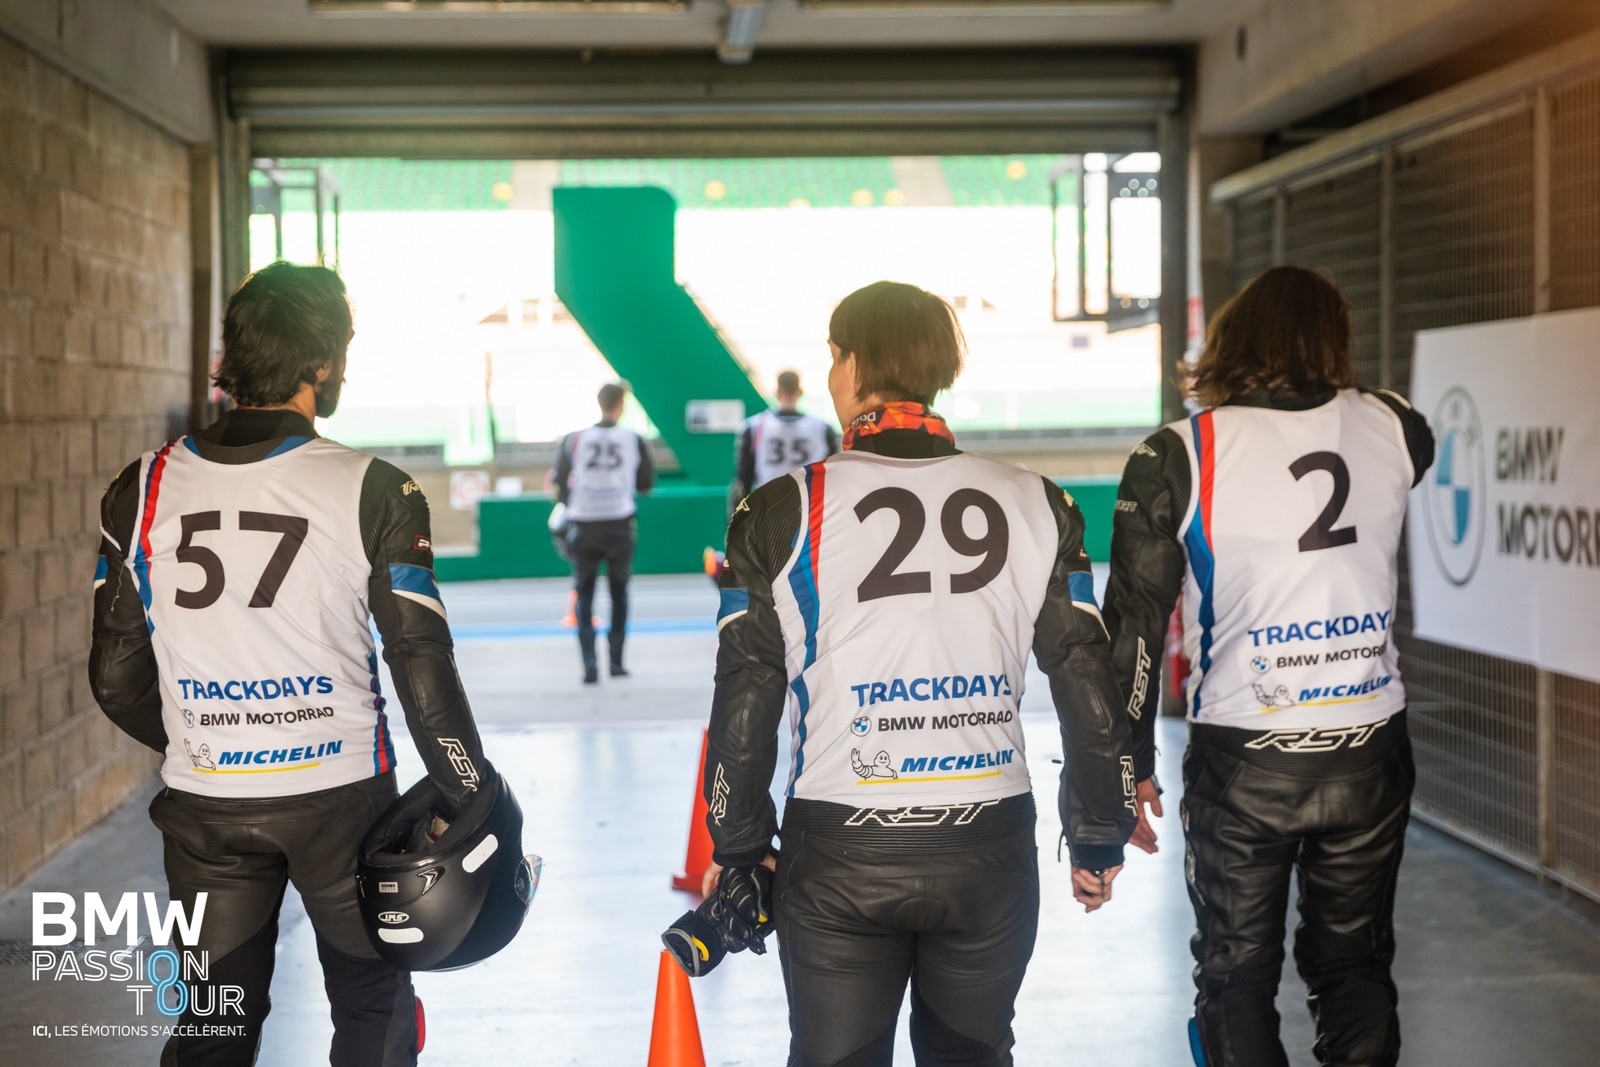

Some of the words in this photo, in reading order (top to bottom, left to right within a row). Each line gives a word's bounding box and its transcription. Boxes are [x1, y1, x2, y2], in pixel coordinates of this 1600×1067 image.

[584, 442, 624, 471] 25
[768, 437, 809, 466] 35
[1496, 424, 1565, 484] BMW
[1288, 450, 1358, 553] 2
[852, 486, 1010, 603] 29
[174, 510, 309, 610] 57
[1248, 610, 1390, 647] TRACKDAY
[1277, 654, 1320, 668] BMW
[178, 675, 334, 701] TRACKDAYS
[200, 712, 240, 726] BMW
[246, 706, 335, 725] MOTORRAD
[878, 716, 926, 732] BMW
[932, 710, 1013, 730] MOTORRAD
[1243, 716, 1391, 753] RST
[218, 739, 343, 765] MICHELIN
[900, 749, 1014, 773] MICHELIN
